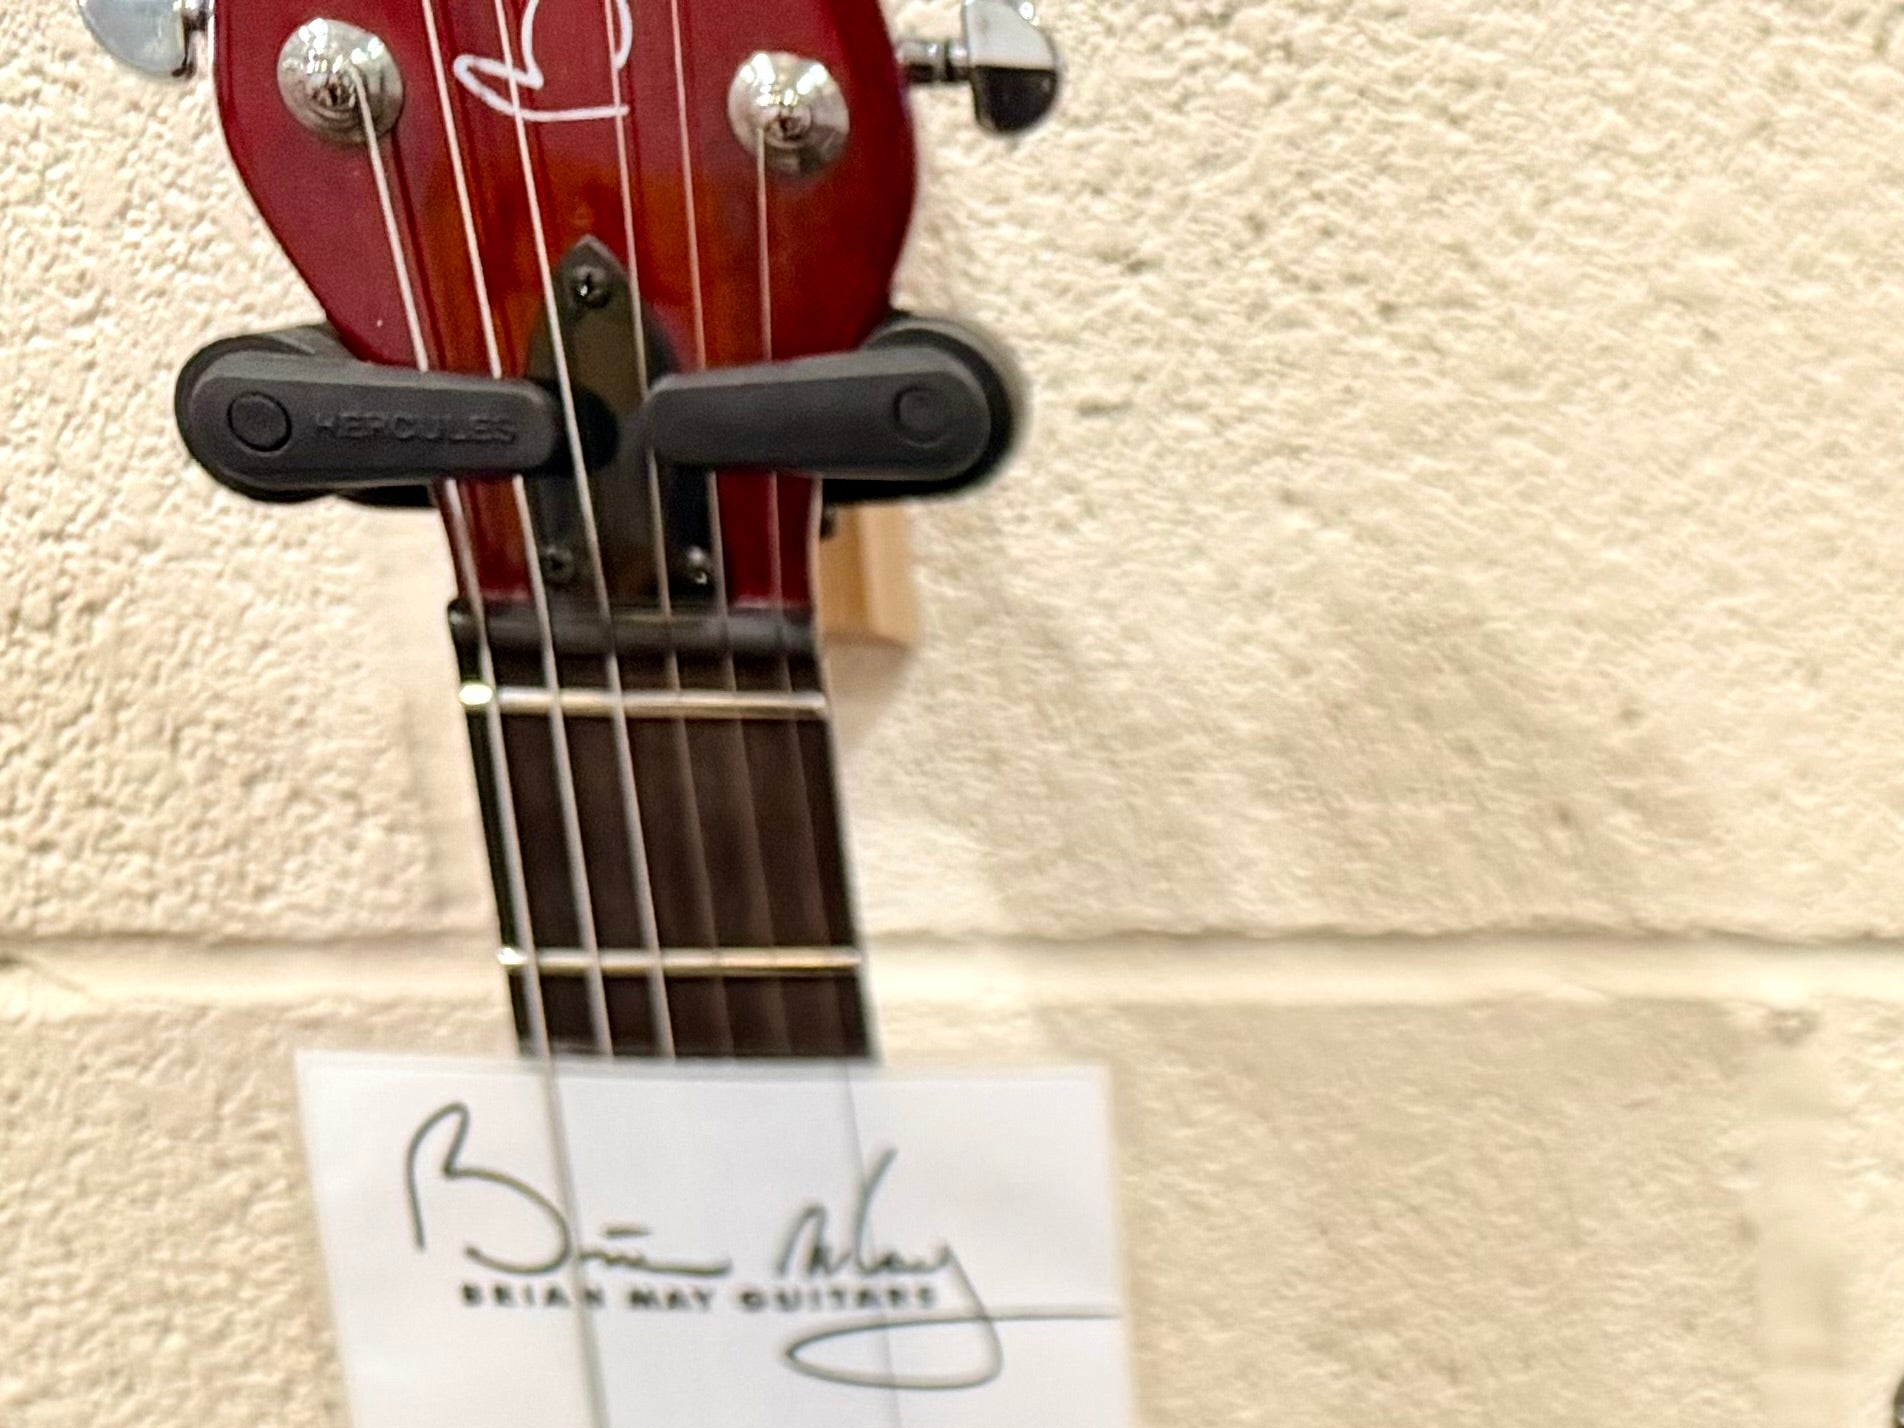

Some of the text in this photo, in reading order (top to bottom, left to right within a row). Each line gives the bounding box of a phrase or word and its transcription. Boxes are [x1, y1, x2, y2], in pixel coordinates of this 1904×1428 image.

[461, 1282, 939, 1313] BRIAN MAY GUITARS
